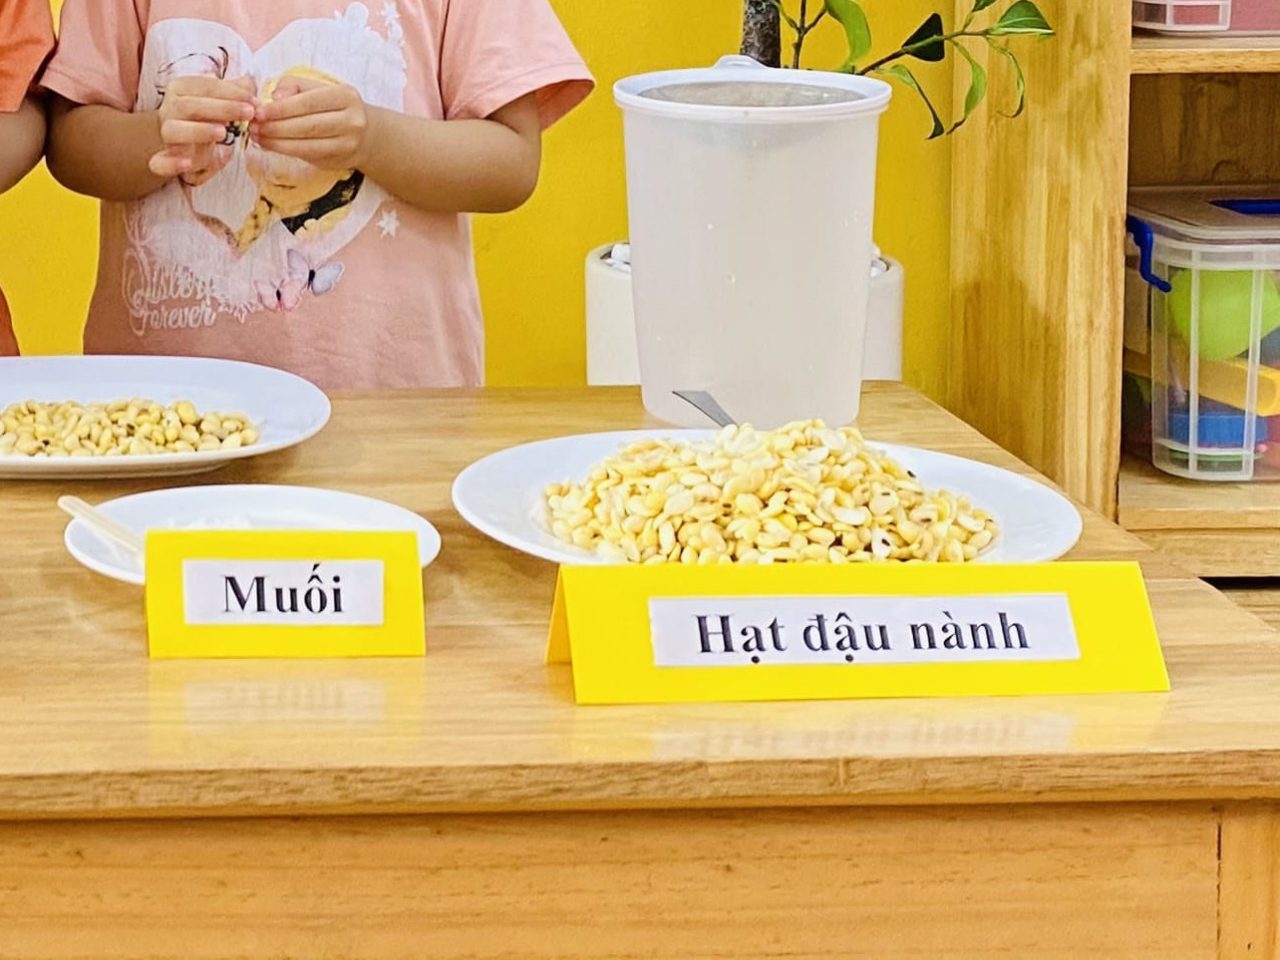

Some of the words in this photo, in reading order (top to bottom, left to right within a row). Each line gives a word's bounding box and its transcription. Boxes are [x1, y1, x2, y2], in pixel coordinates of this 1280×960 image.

[223, 562, 345, 615] Muối
[696, 613, 788, 665] Hạt
[802, 611, 892, 663] đậu
[911, 610, 1031, 651] nành
